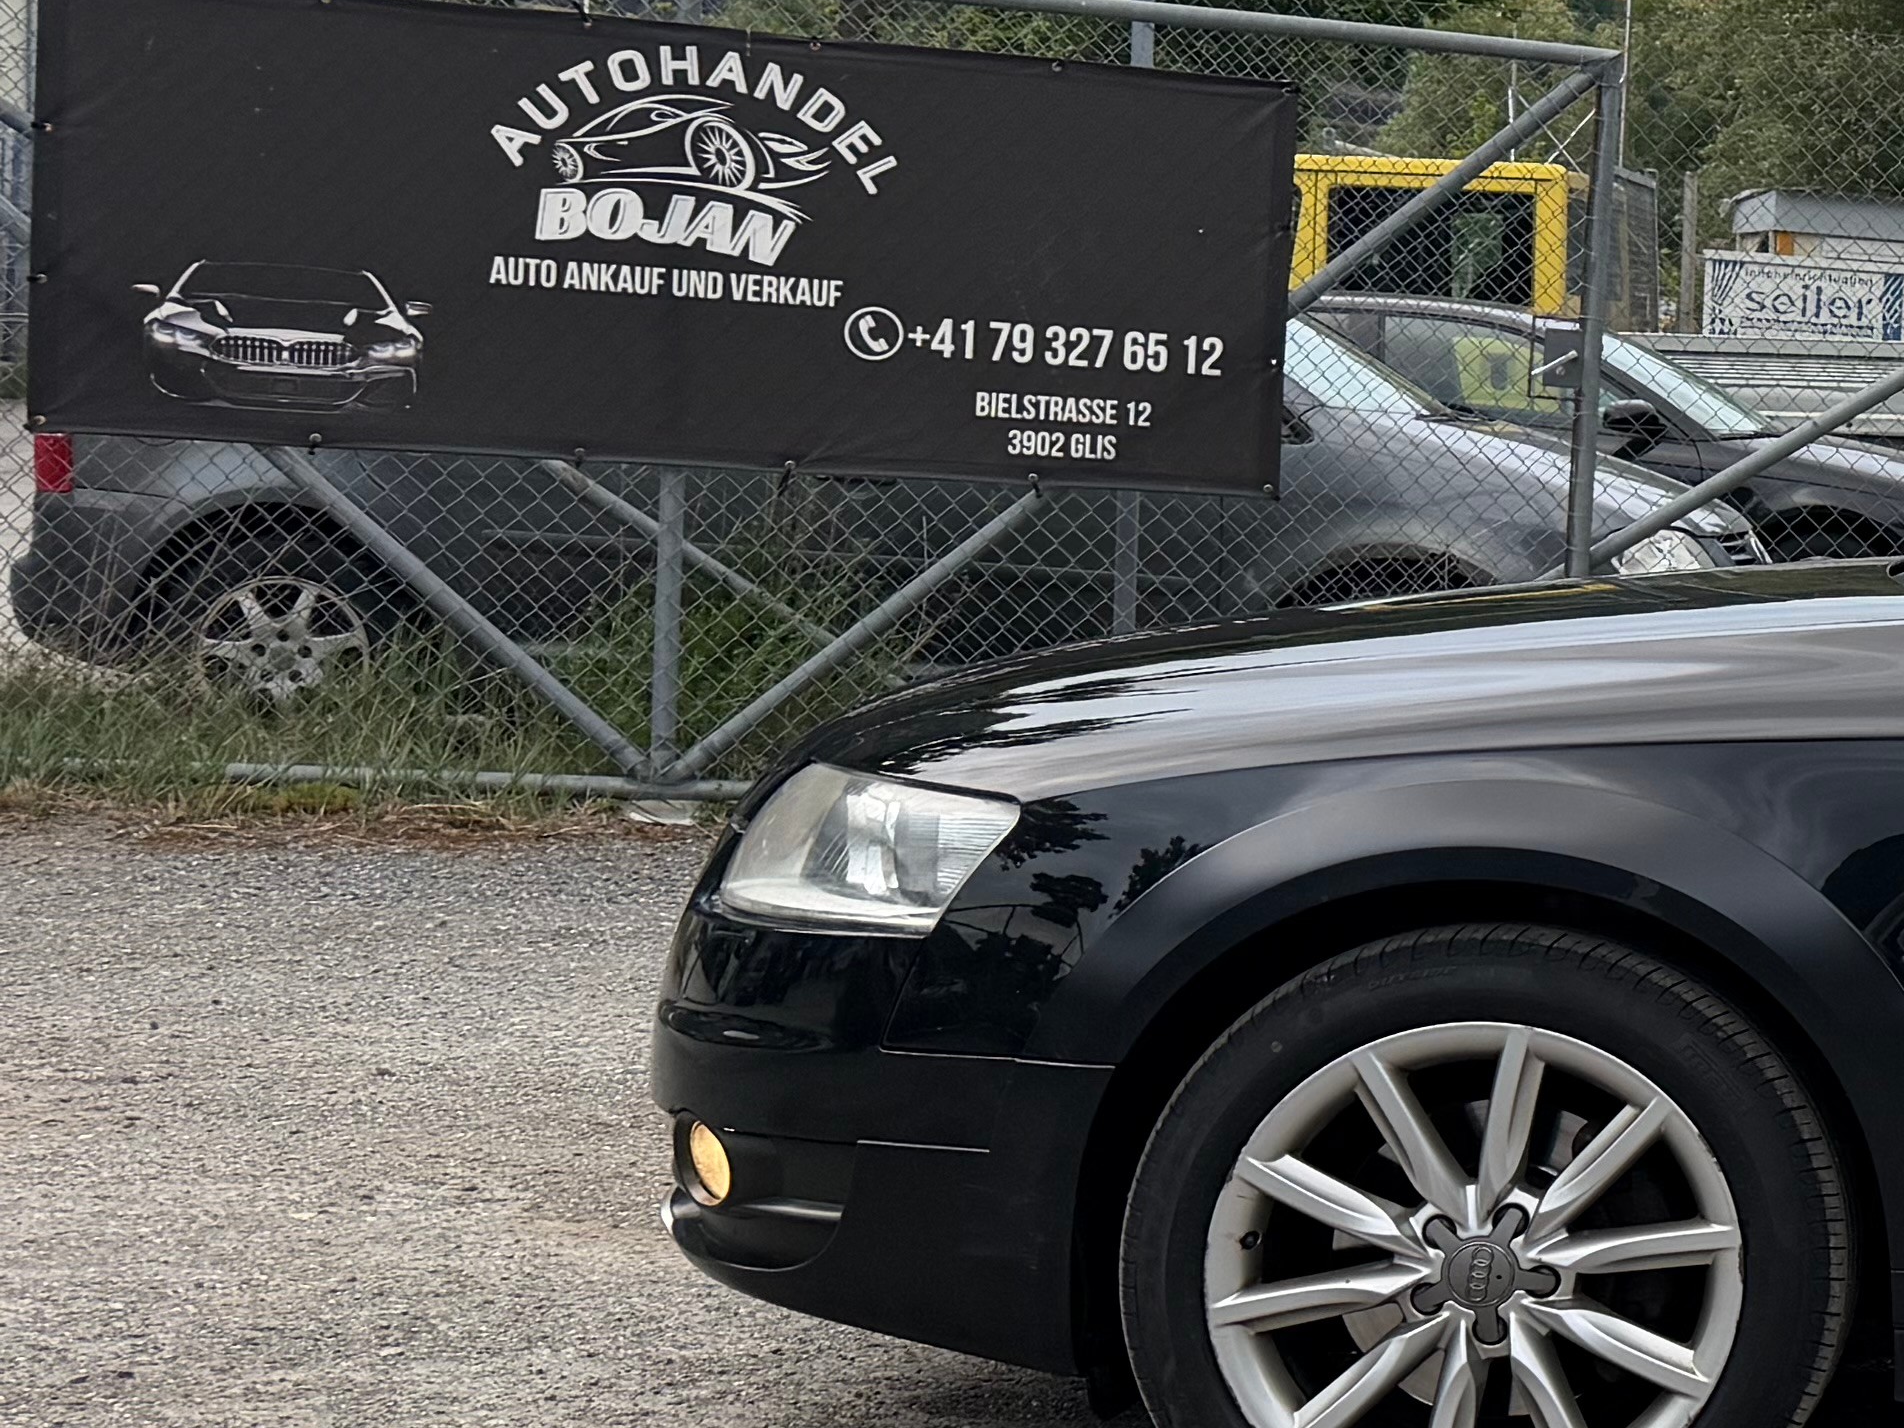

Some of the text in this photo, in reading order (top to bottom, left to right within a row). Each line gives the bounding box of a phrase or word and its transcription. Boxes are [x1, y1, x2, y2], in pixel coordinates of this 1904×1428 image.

[490, 45, 898, 195] AUTOHANDEL
[535, 187, 797, 267] BOJAN
[489, 255, 845, 309] AUTO ANKAUF UND VERKAUF
[907, 318, 1225, 377] +41 79 327 65 12
[975, 391, 1152, 427] BIELSTRASSE 12
[1007, 429, 1118, 461] 3902 GLIS
